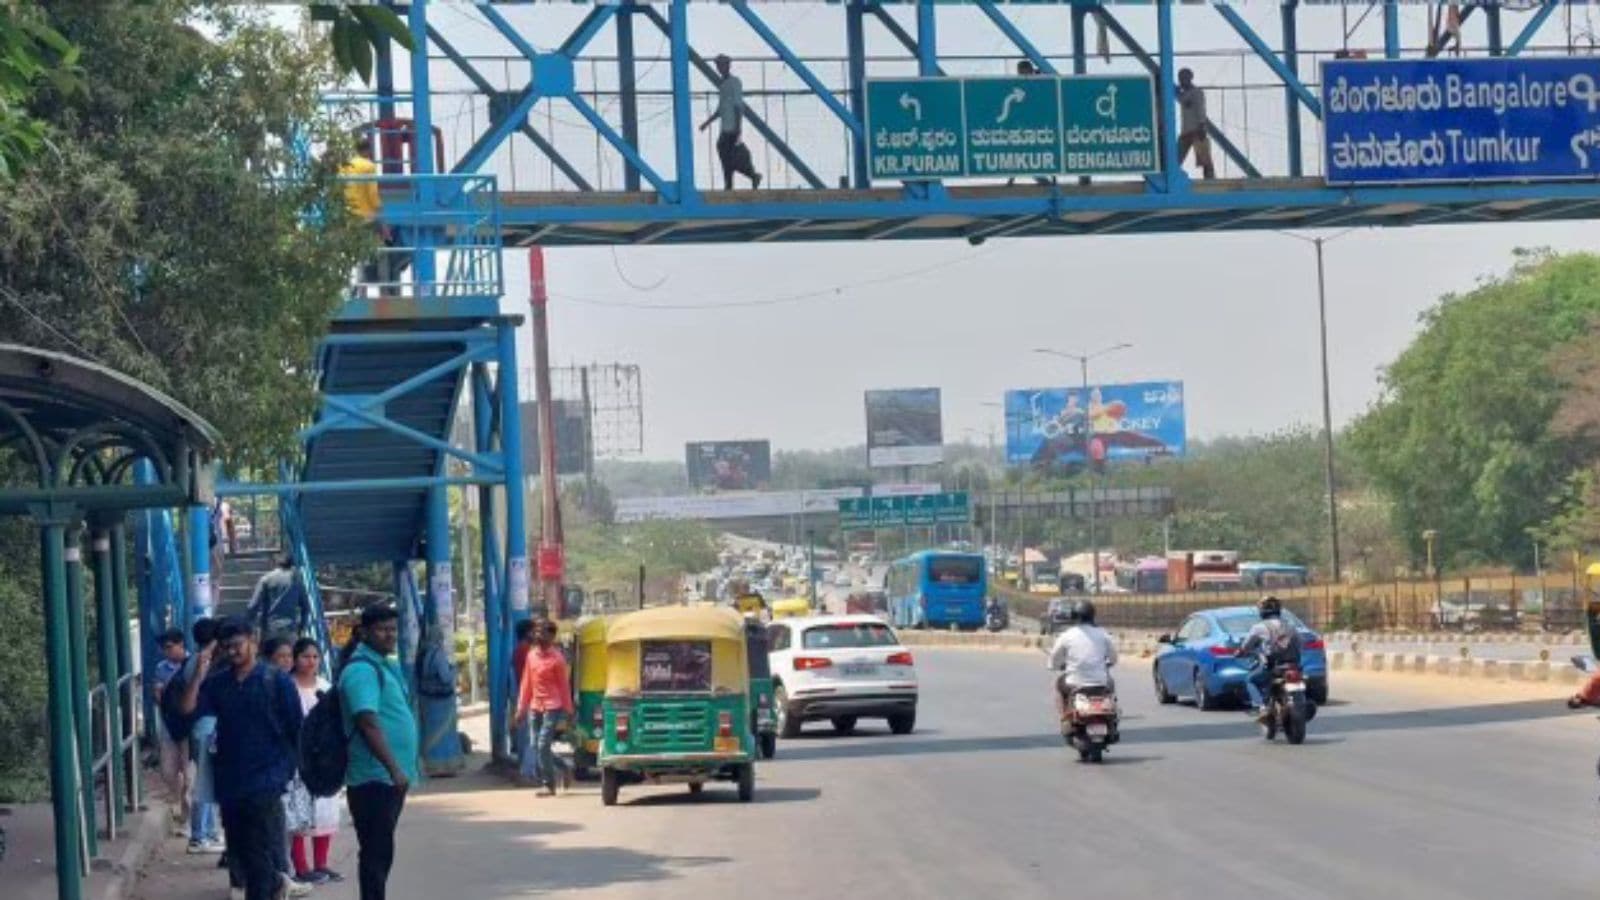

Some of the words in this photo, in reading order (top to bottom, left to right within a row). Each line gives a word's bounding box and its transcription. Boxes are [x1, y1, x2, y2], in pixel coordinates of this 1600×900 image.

[1447, 74, 1567, 115] Bangalore
[1067, 150, 1151, 169] BENGALURU
[1446, 129, 1541, 164] Tumkur
[973, 152, 1056, 171] TUMKUR
